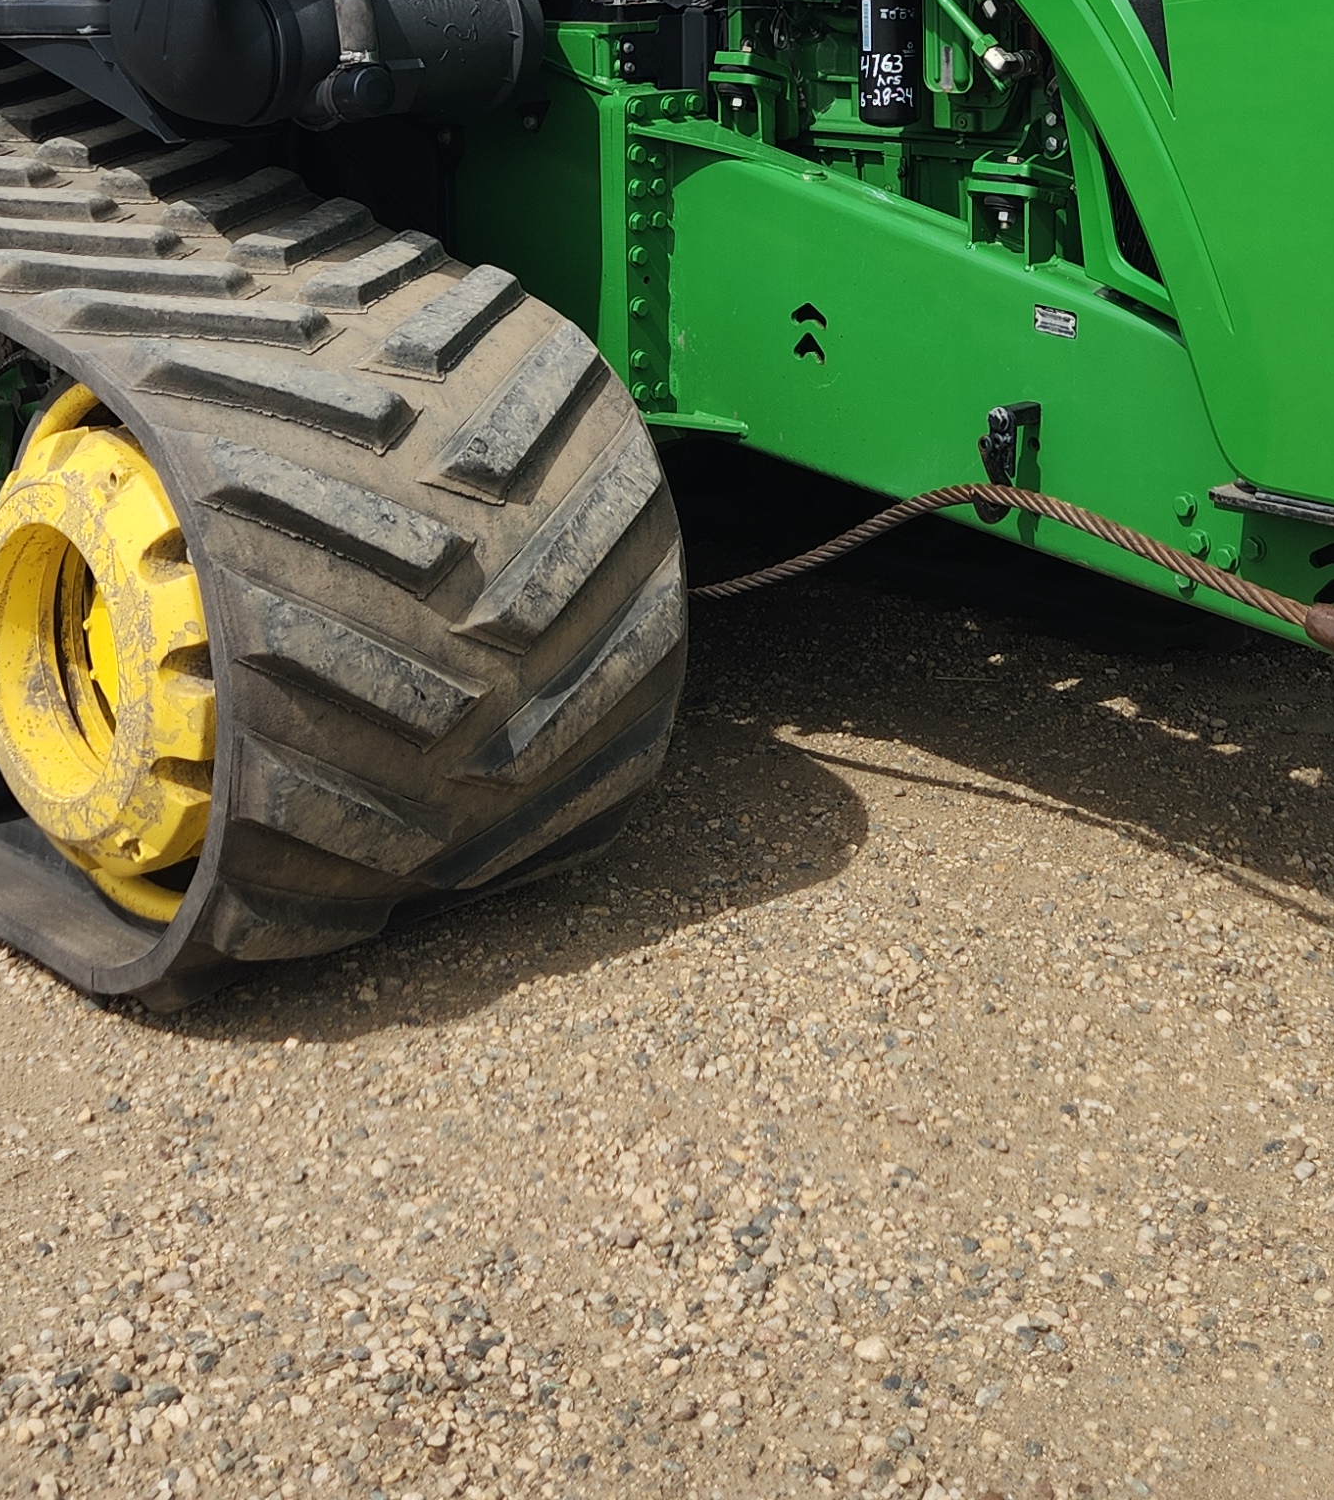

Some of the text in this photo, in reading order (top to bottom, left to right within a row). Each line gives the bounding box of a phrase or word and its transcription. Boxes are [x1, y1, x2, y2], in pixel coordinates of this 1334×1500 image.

[860, 53, 903, 78] 4763
[877, 74, 903, 87] hrs
[860, 86, 913, 108] 6-28-24
